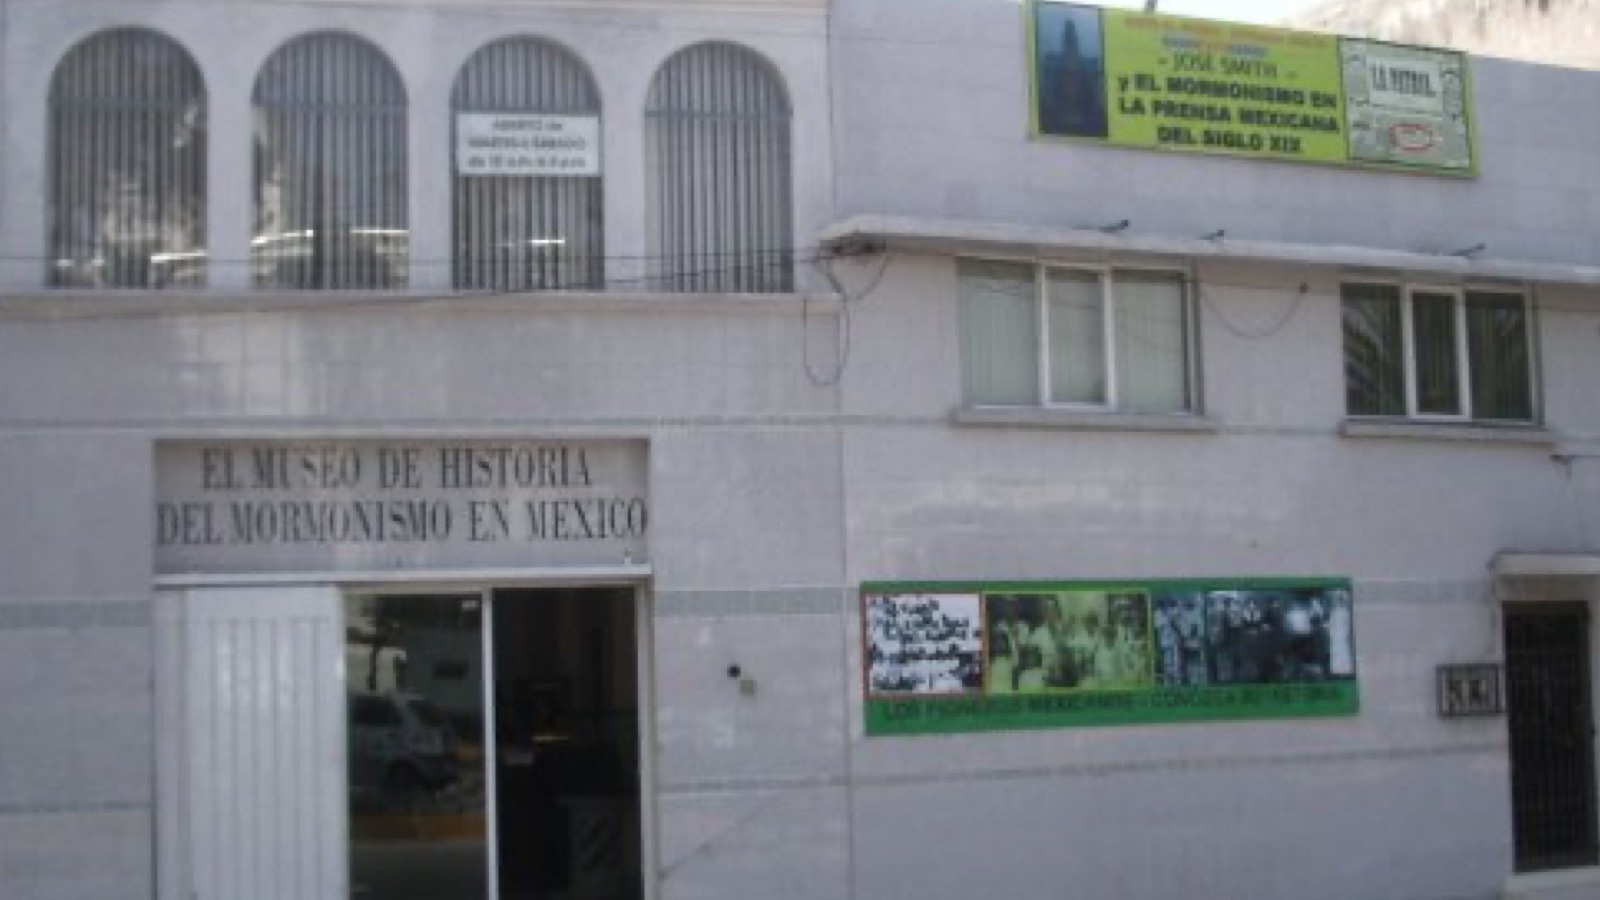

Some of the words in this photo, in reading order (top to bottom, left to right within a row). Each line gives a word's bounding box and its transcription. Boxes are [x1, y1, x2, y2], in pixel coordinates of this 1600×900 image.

[1221, 56, 1278, 78] SMITH
[1135, 74, 1161, 92] EL
[1167, 76, 1305, 105] MORMONISMO
[1310, 91, 1337, 108] EN
[1119, 97, 1146, 115] LA
[1152, 99, 1232, 122] PRENSA
[1238, 107, 1339, 132] MEXICANA
[1157, 126, 1197, 145] DEL
[1203, 129, 1263, 151] SIGLO
[1269, 135, 1302, 153] XIX
[202, 447, 242, 491] EL
[249, 446, 362, 490] MUSEO
[376, 446, 423, 490] DE
[436, 445, 593, 490] HISTORIA
[156, 502, 224, 547] DEL
[229, 498, 454, 546] MORMONISMO
[467, 498, 511, 543] EN
[526, 497, 649, 542] MEXICO
